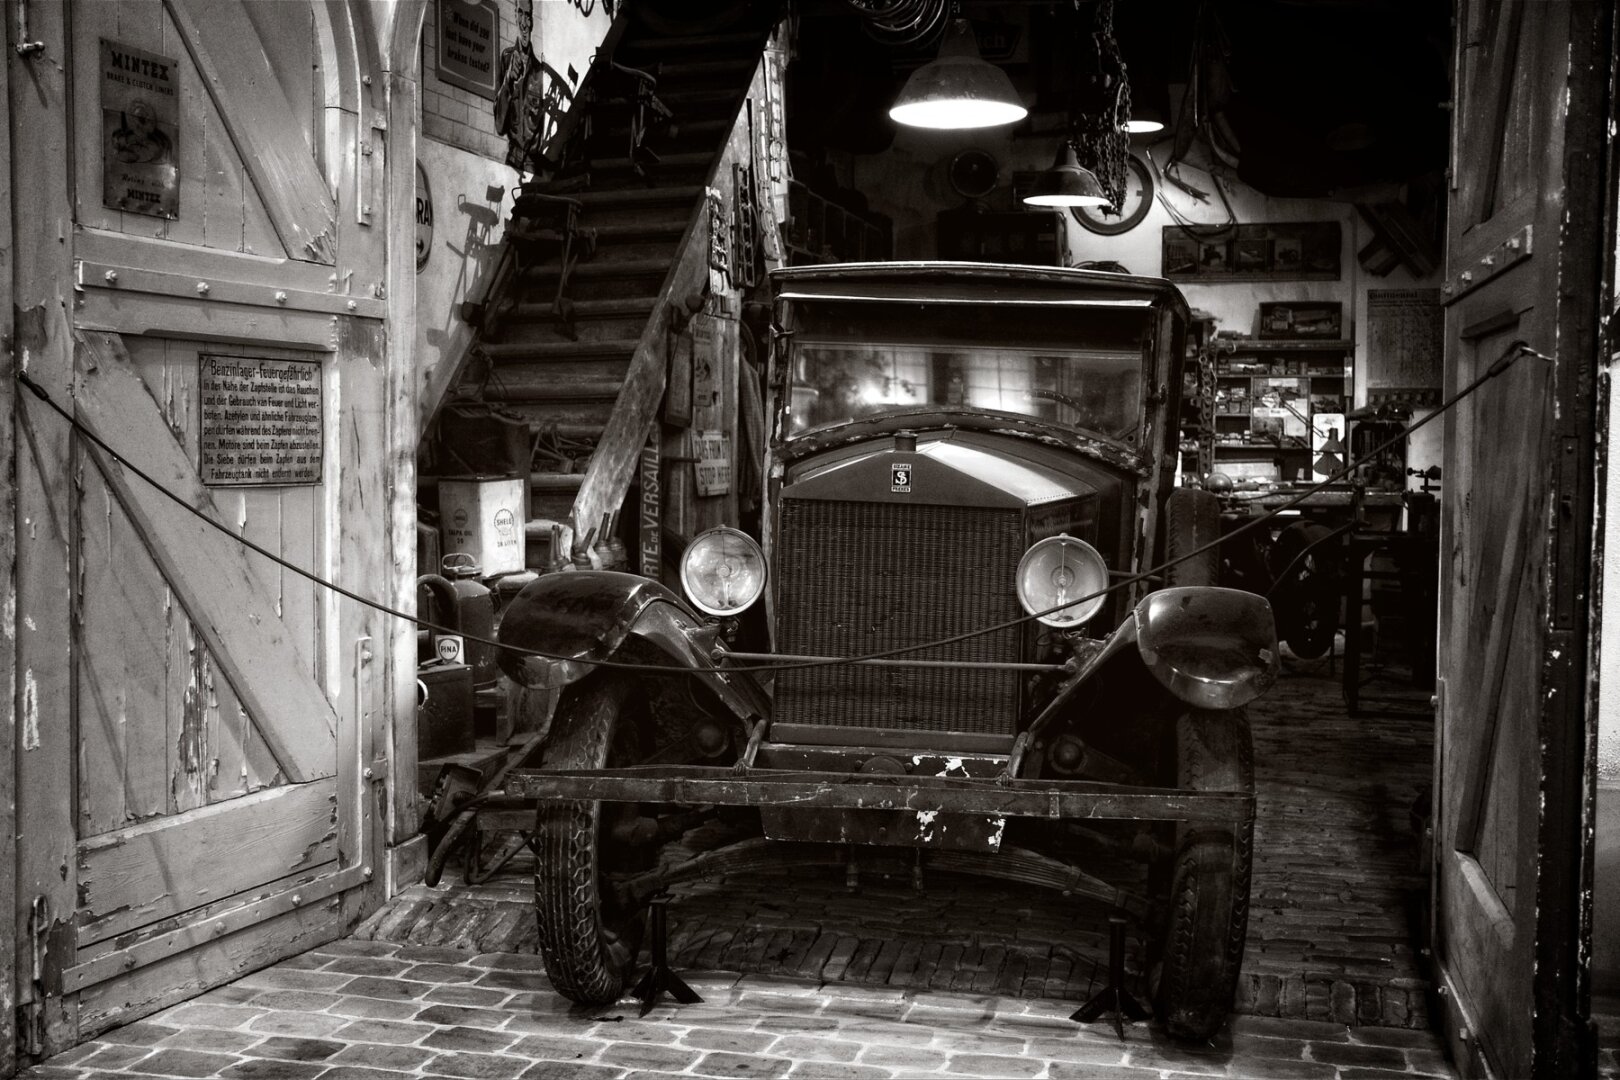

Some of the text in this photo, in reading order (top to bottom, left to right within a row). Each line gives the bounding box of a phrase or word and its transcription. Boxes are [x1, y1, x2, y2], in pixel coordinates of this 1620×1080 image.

[470, 20, 479, 33] did
[480, 27, 490, 40] you
[111, 50, 169, 81] MINTEX
[127, 188, 161, 204] MINTEX
[204, 380, 210, 390] In
[211, 380, 221, 391] der
[239, 381, 249, 392] der
[250, 382, 277, 394] Zapfstelle
[286, 384, 296, 394] das
[297, 384, 319, 395] Rauchen
[204, 396, 216, 406] und
[217, 395, 227, 406] der
[228, 394, 256, 406] Gebrauch
[268, 397, 283, 407] Feuer
[284, 398, 294, 408] und
[295, 398, 306, 408] Licht
[224, 410, 249, 423] Azetylen
[250, 410, 261, 421] und
[204, 426, 215, 436] pen
[262, 425, 272, 436] des
[218, 439, 240, 450] Motore
[242, 439, 254, 450] sind
[256, 439, 270, 450] beim
[270, 439, 288, 451] Zapfen
[204, 453, 214, 464] Die
[217, 453, 234, 464] Siebe
[260, 454, 273, 464] beim
[276, 453, 293, 466] Zapfen
[296, 456, 306, 464] aus
[310, 454, 320, 464] dem
[210, 468, 252, 481] Fahrzeugtank
[255, 468, 270, 479] nicht
[699, 467, 716, 485] STOP
[496, 518, 512, 526] SHELL
[643, 542, 660, 578] RTE
